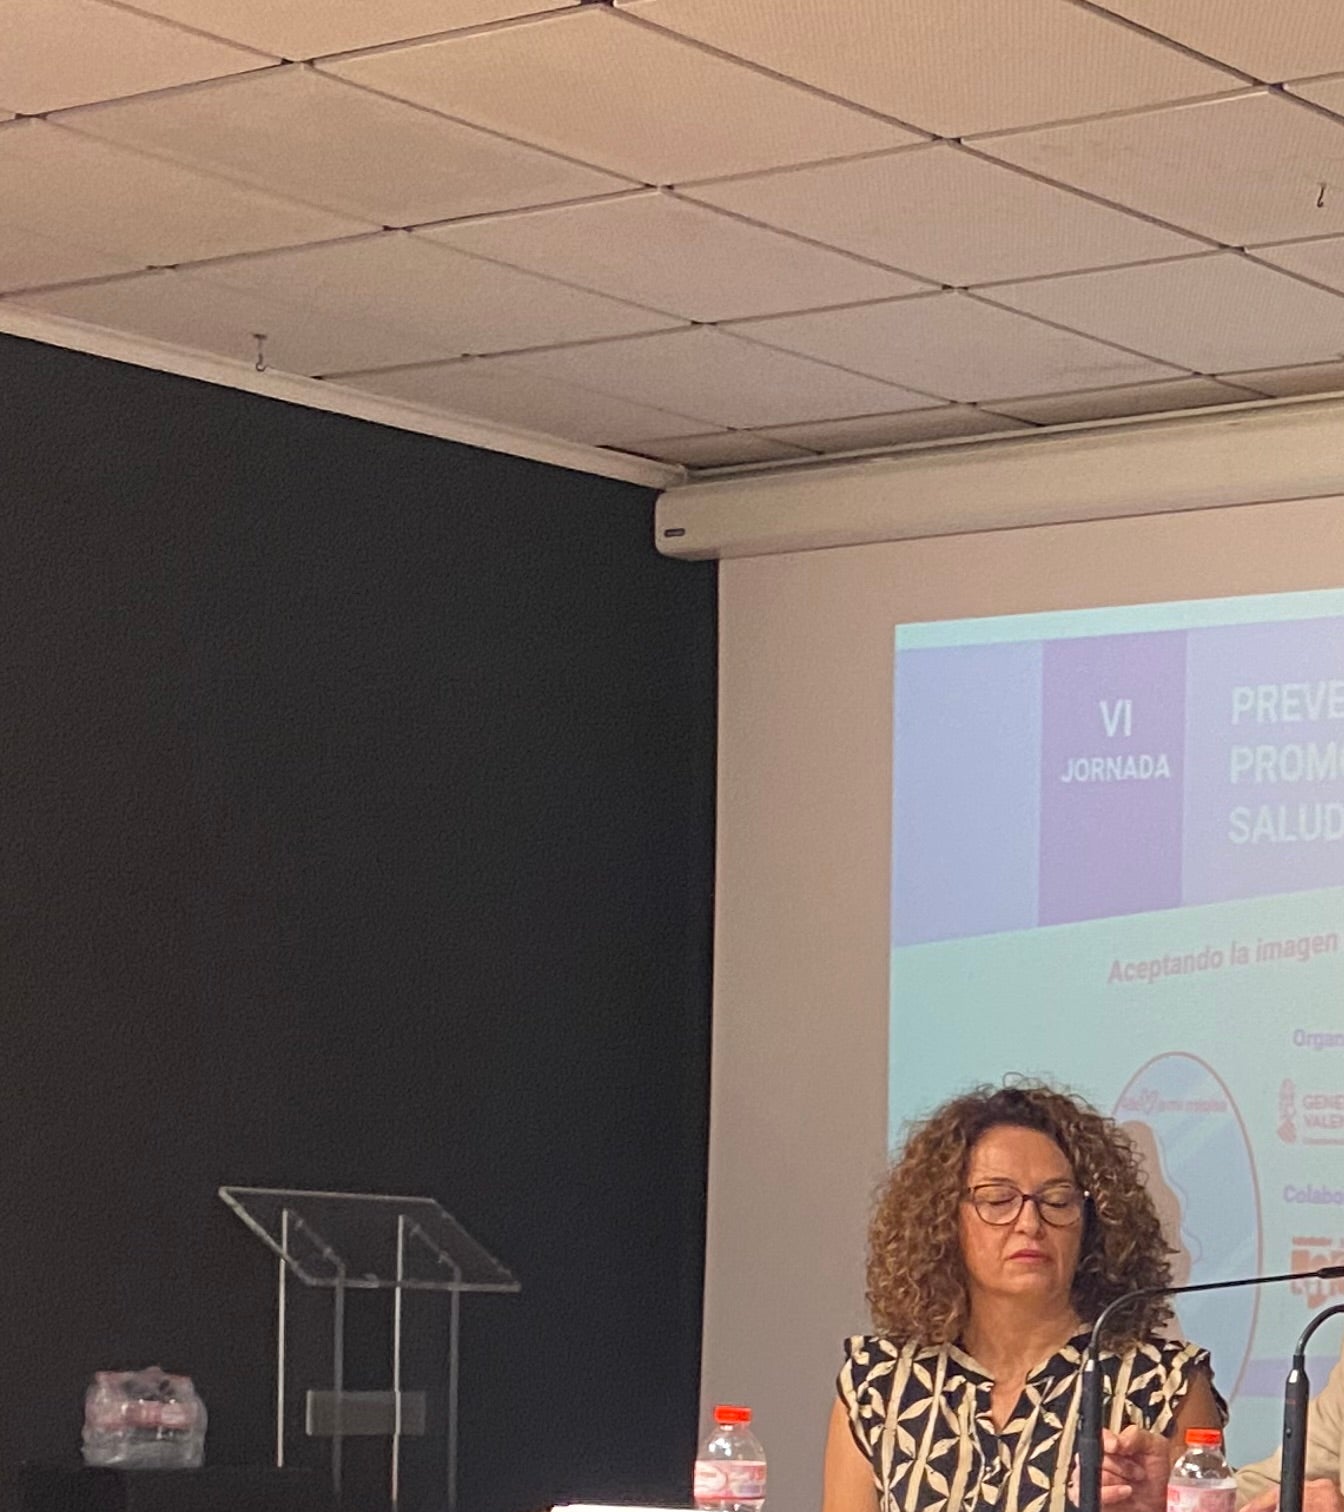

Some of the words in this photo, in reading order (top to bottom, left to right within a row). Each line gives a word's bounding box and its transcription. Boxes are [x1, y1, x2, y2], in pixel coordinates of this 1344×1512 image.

[1099, 698, 1132, 738] VI
[1061, 753, 1171, 783] JORNADA
[1108, 944, 1223, 984] Aceptando
[1230, 940, 1249, 965] la
[1256, 932, 1338, 962] imagen
